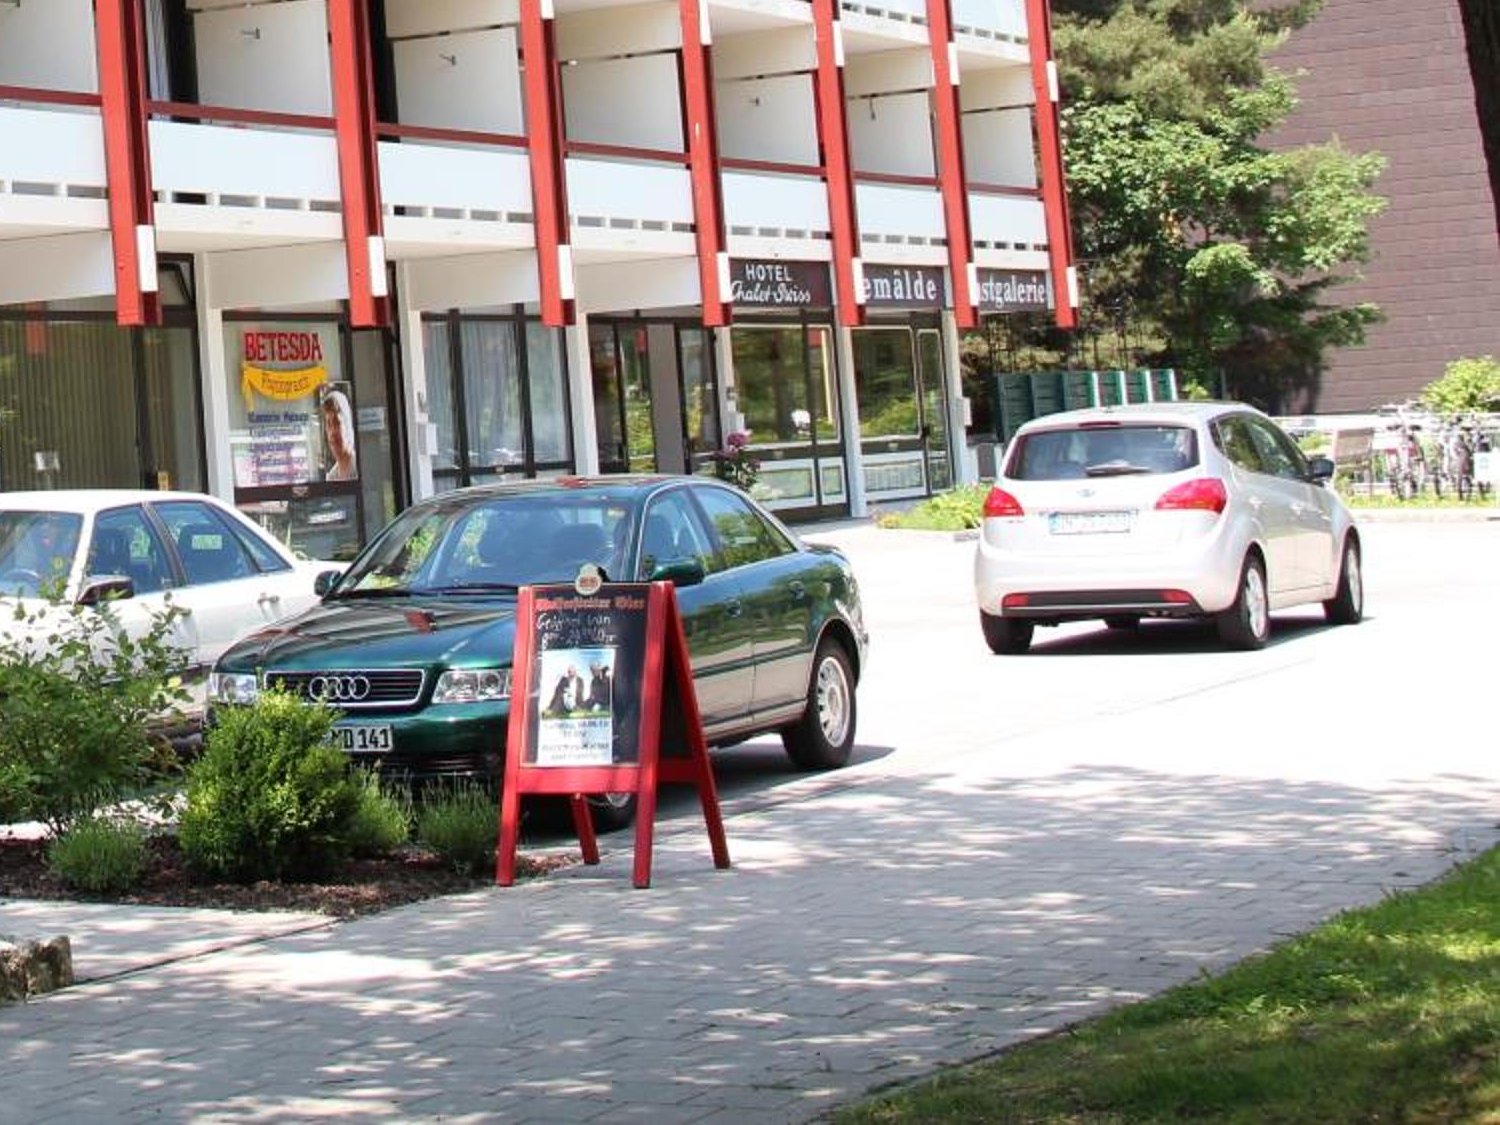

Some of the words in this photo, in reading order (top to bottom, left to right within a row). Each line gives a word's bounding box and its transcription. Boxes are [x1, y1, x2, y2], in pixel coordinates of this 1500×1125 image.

[745, 263, 793, 282] HOTEL
[862, 269, 938, 300] emälde
[978, 275, 1046, 308] stgalerie
[244, 332, 323, 362] BETESDA
[357, 728, 390, 749] 141
